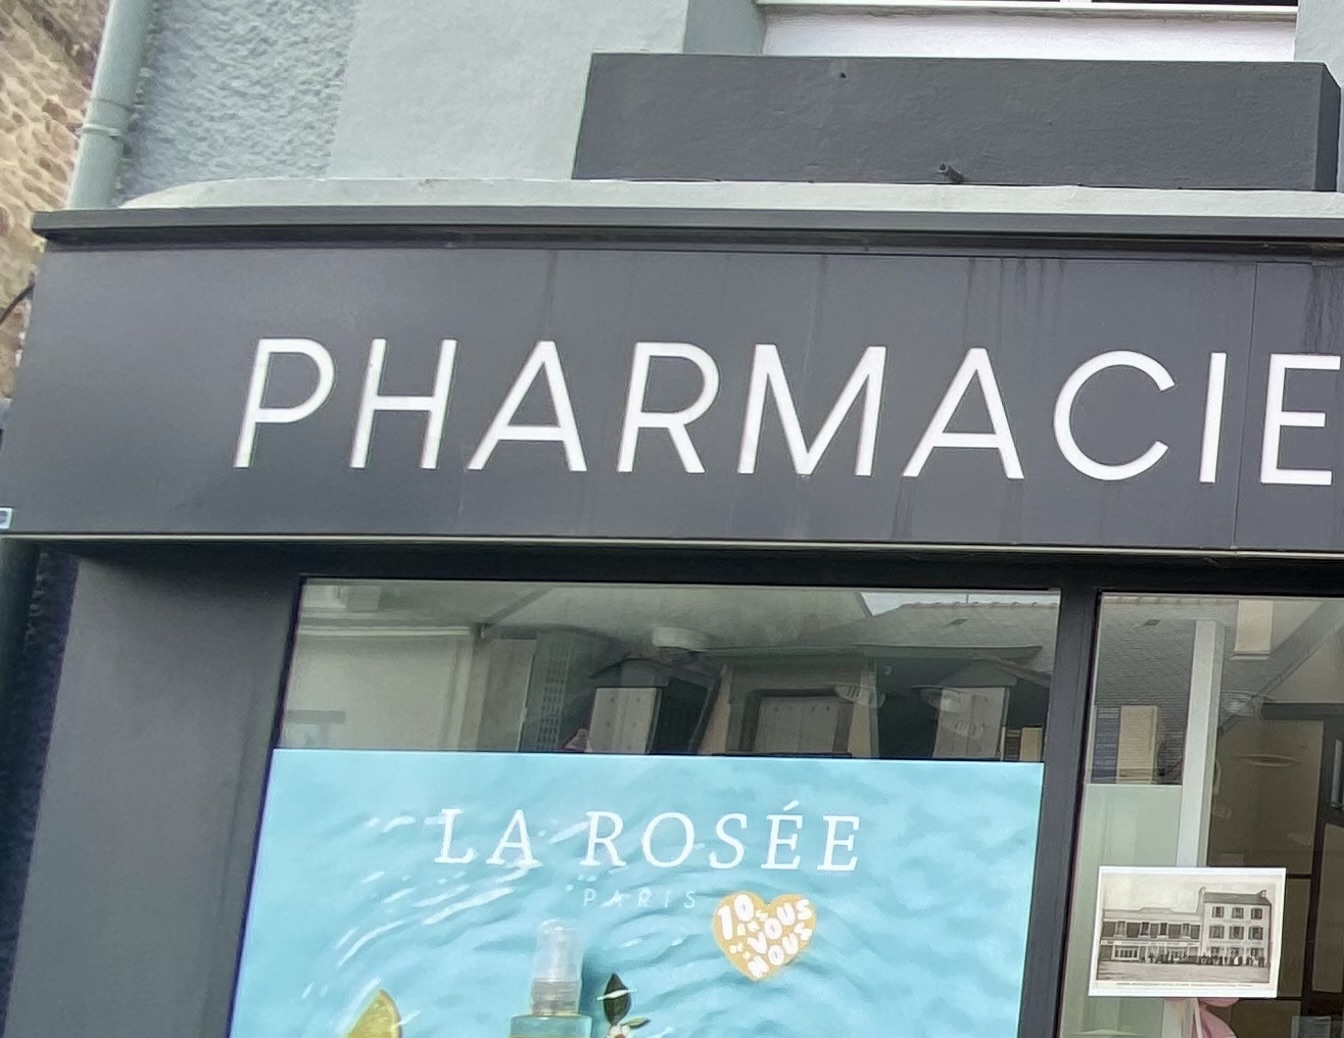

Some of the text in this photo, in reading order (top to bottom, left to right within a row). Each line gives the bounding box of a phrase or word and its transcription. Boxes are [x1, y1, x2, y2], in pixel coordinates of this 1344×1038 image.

[233, 335, 1341, 487] PHARMACIE
[434, 800, 860, 872] LA ROSÉE
[583, 888, 697, 909] PARIS
[717, 894, 755, 941] 10
[747, 898, 813, 955] VOUS
